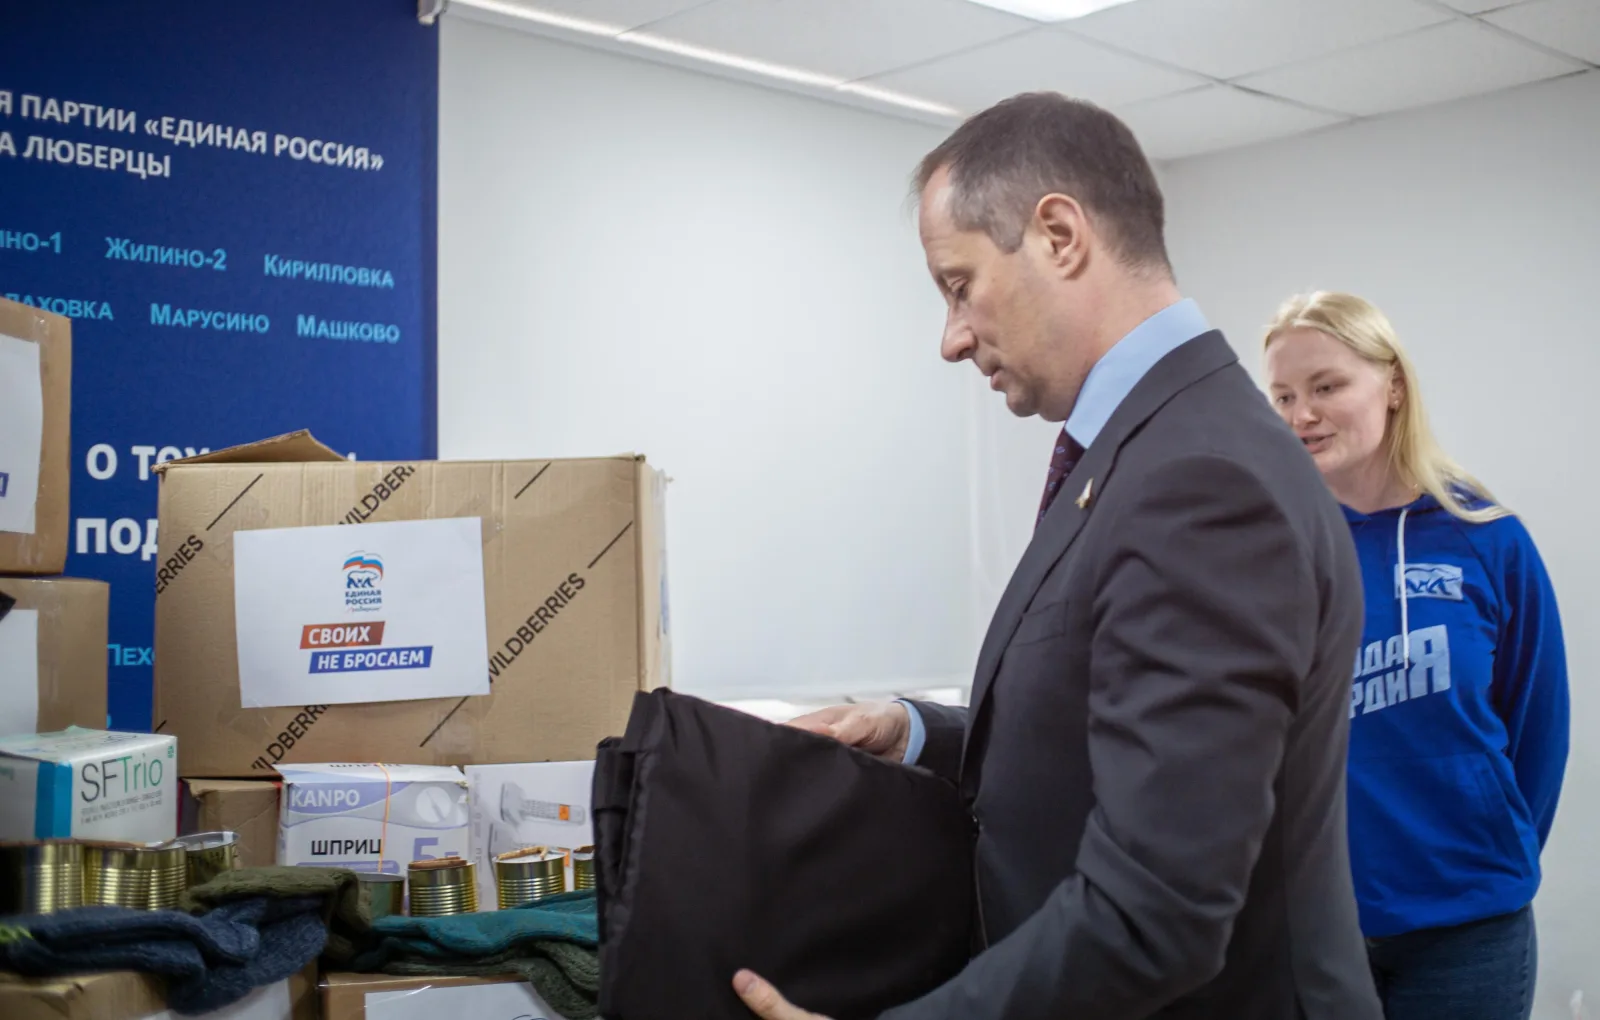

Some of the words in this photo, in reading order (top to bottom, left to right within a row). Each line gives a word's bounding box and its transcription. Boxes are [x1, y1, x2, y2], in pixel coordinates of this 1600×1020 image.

[21, 94, 136, 133] ПАРТИИ
[144, 116, 266, 154] «ЕДИНАЯ
[274, 134, 384, 171] РОССИЯ»
[23, 135, 171, 180] ЛЮБЕРЦЫ
[308, 626, 371, 645] СВОИХ
[318, 654, 340, 670] НЕ
[343, 650, 425, 669] БРОСАЕМ
[291, 788, 361, 807] KANPO
